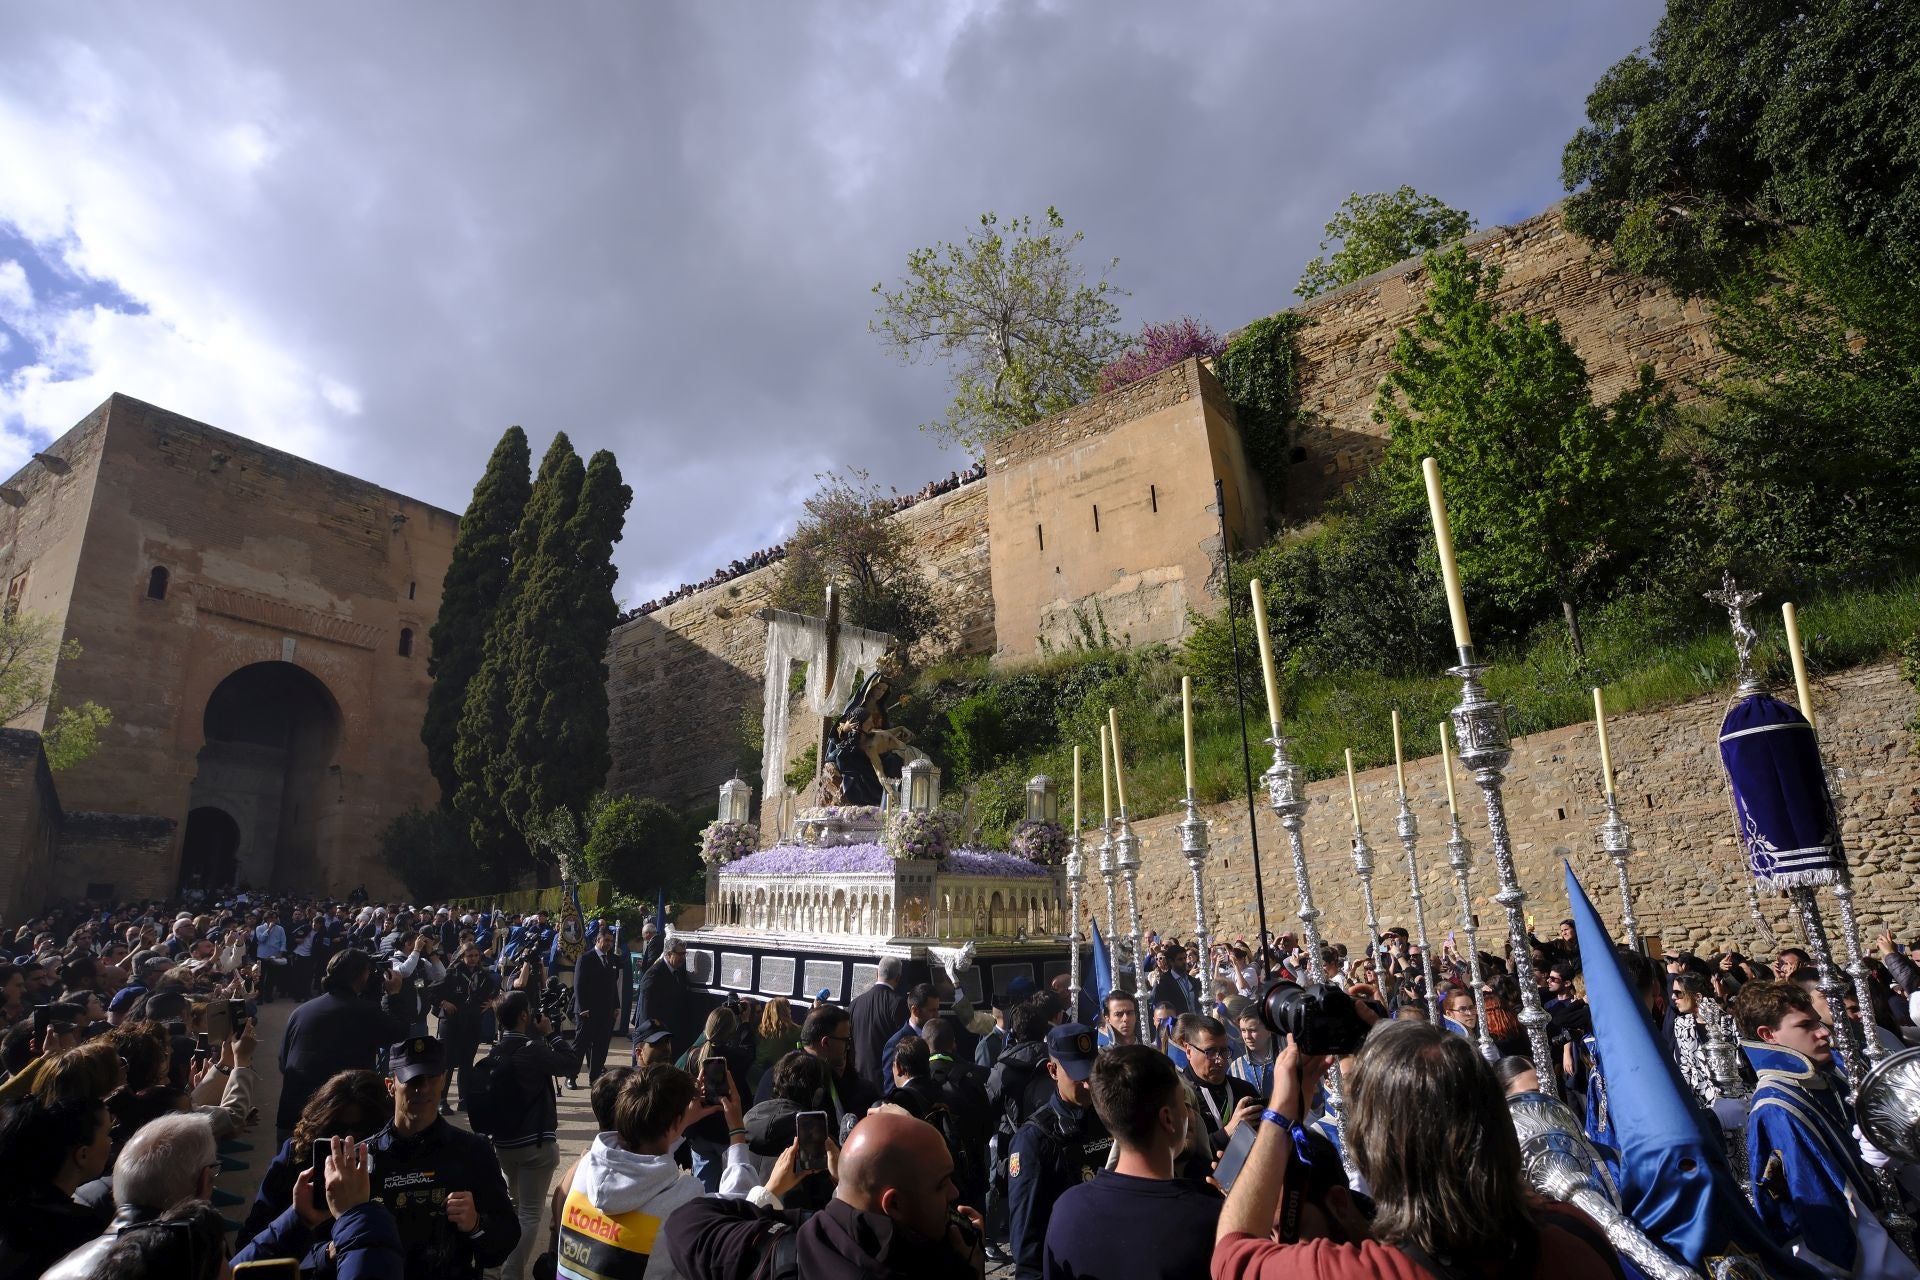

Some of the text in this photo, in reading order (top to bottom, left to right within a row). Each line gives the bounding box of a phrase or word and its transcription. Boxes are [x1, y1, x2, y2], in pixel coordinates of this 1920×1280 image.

[384, 1177, 435, 1189] NACIONAL
[568, 1205, 621, 1242] Kodak
[1283, 1190, 1300, 1238] Canon
[563, 1237, 592, 1265] Gold
